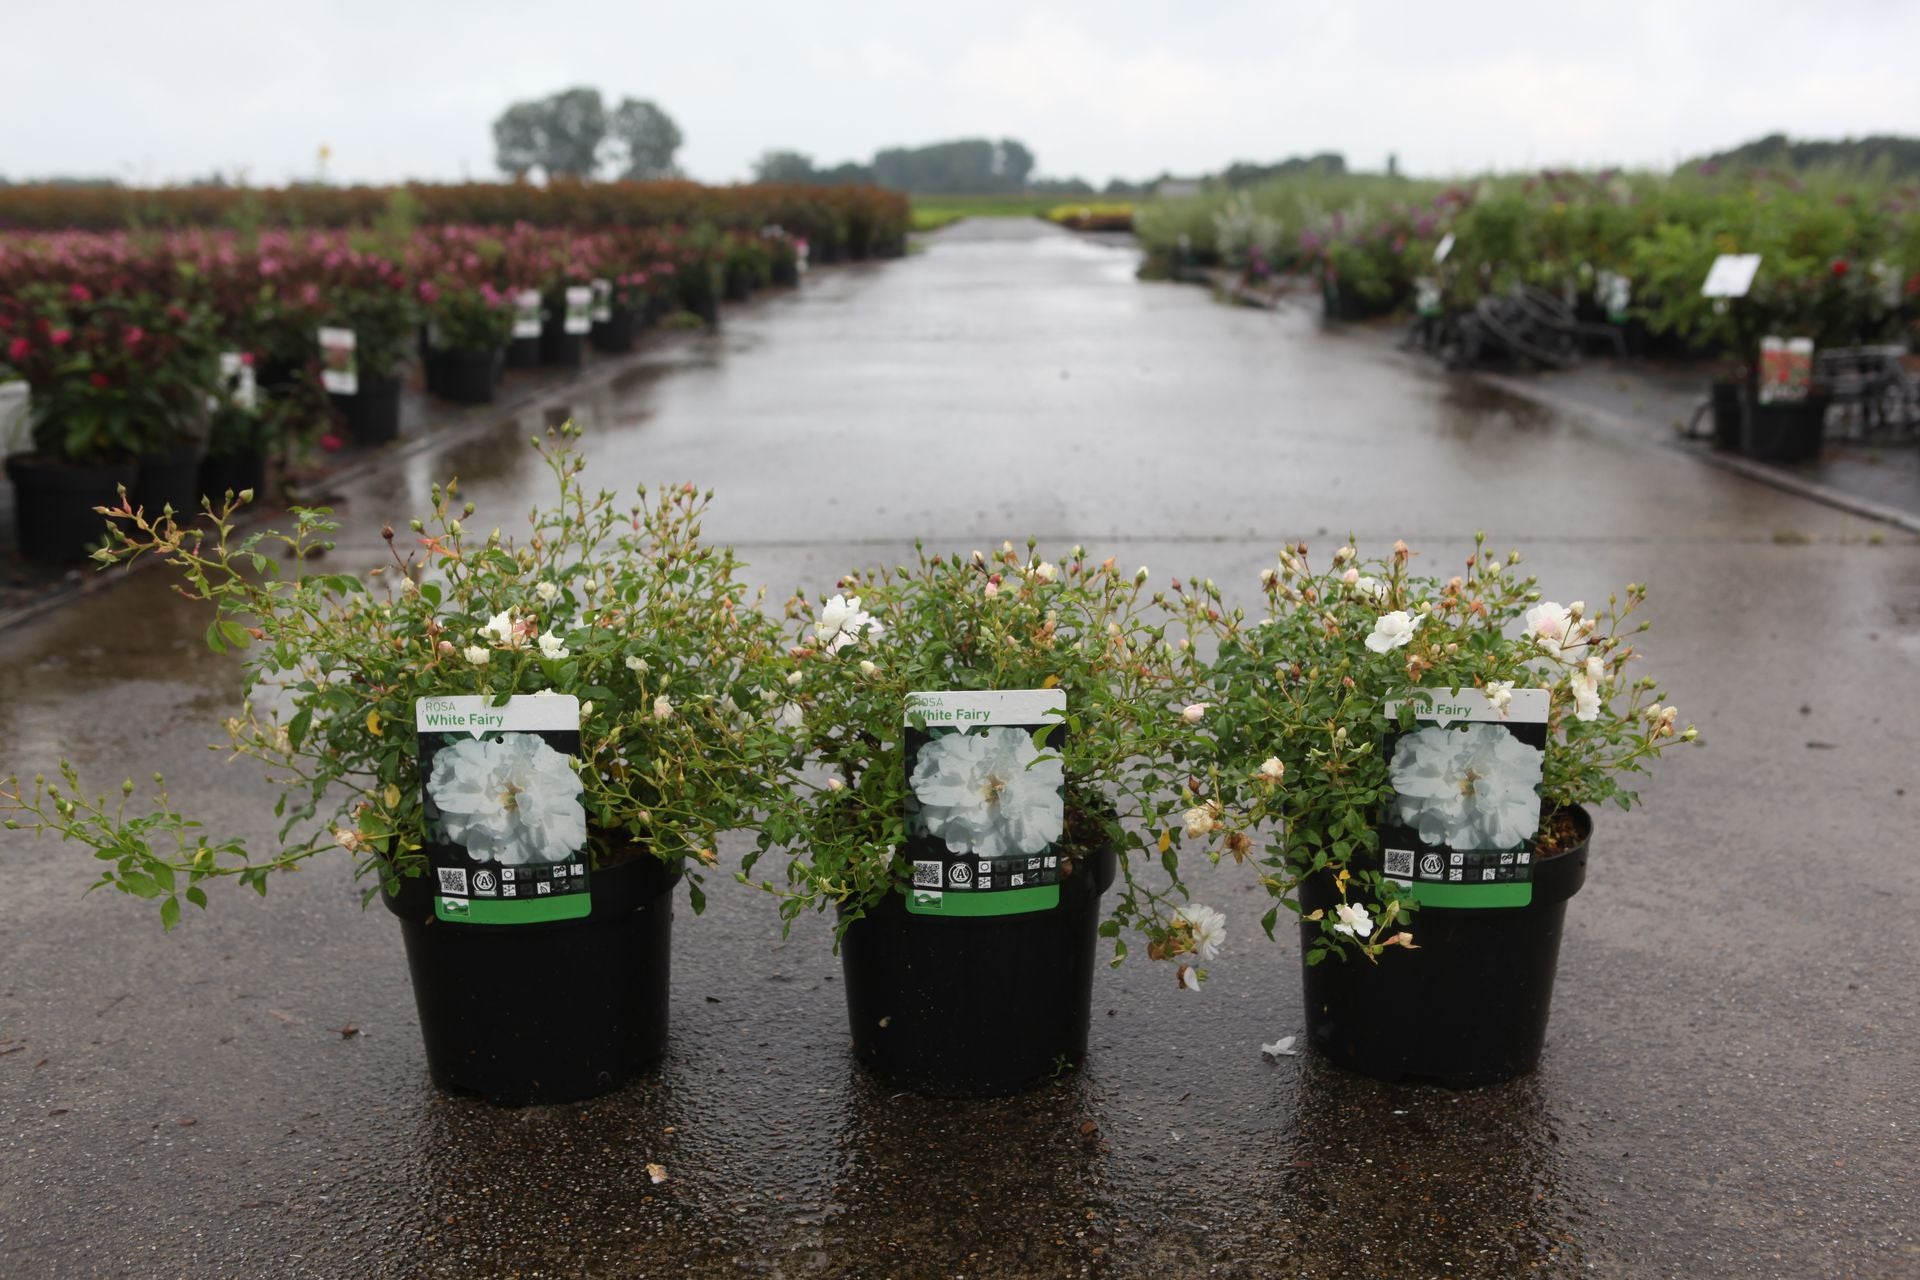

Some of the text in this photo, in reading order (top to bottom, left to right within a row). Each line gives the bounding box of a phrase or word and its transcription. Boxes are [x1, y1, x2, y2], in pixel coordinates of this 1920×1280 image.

[425, 702, 456, 711] ROSA
[1437, 704, 1472, 717] Fairy
[426, 713, 504, 727] White Fairy
[956, 709, 991, 722] Fairy
